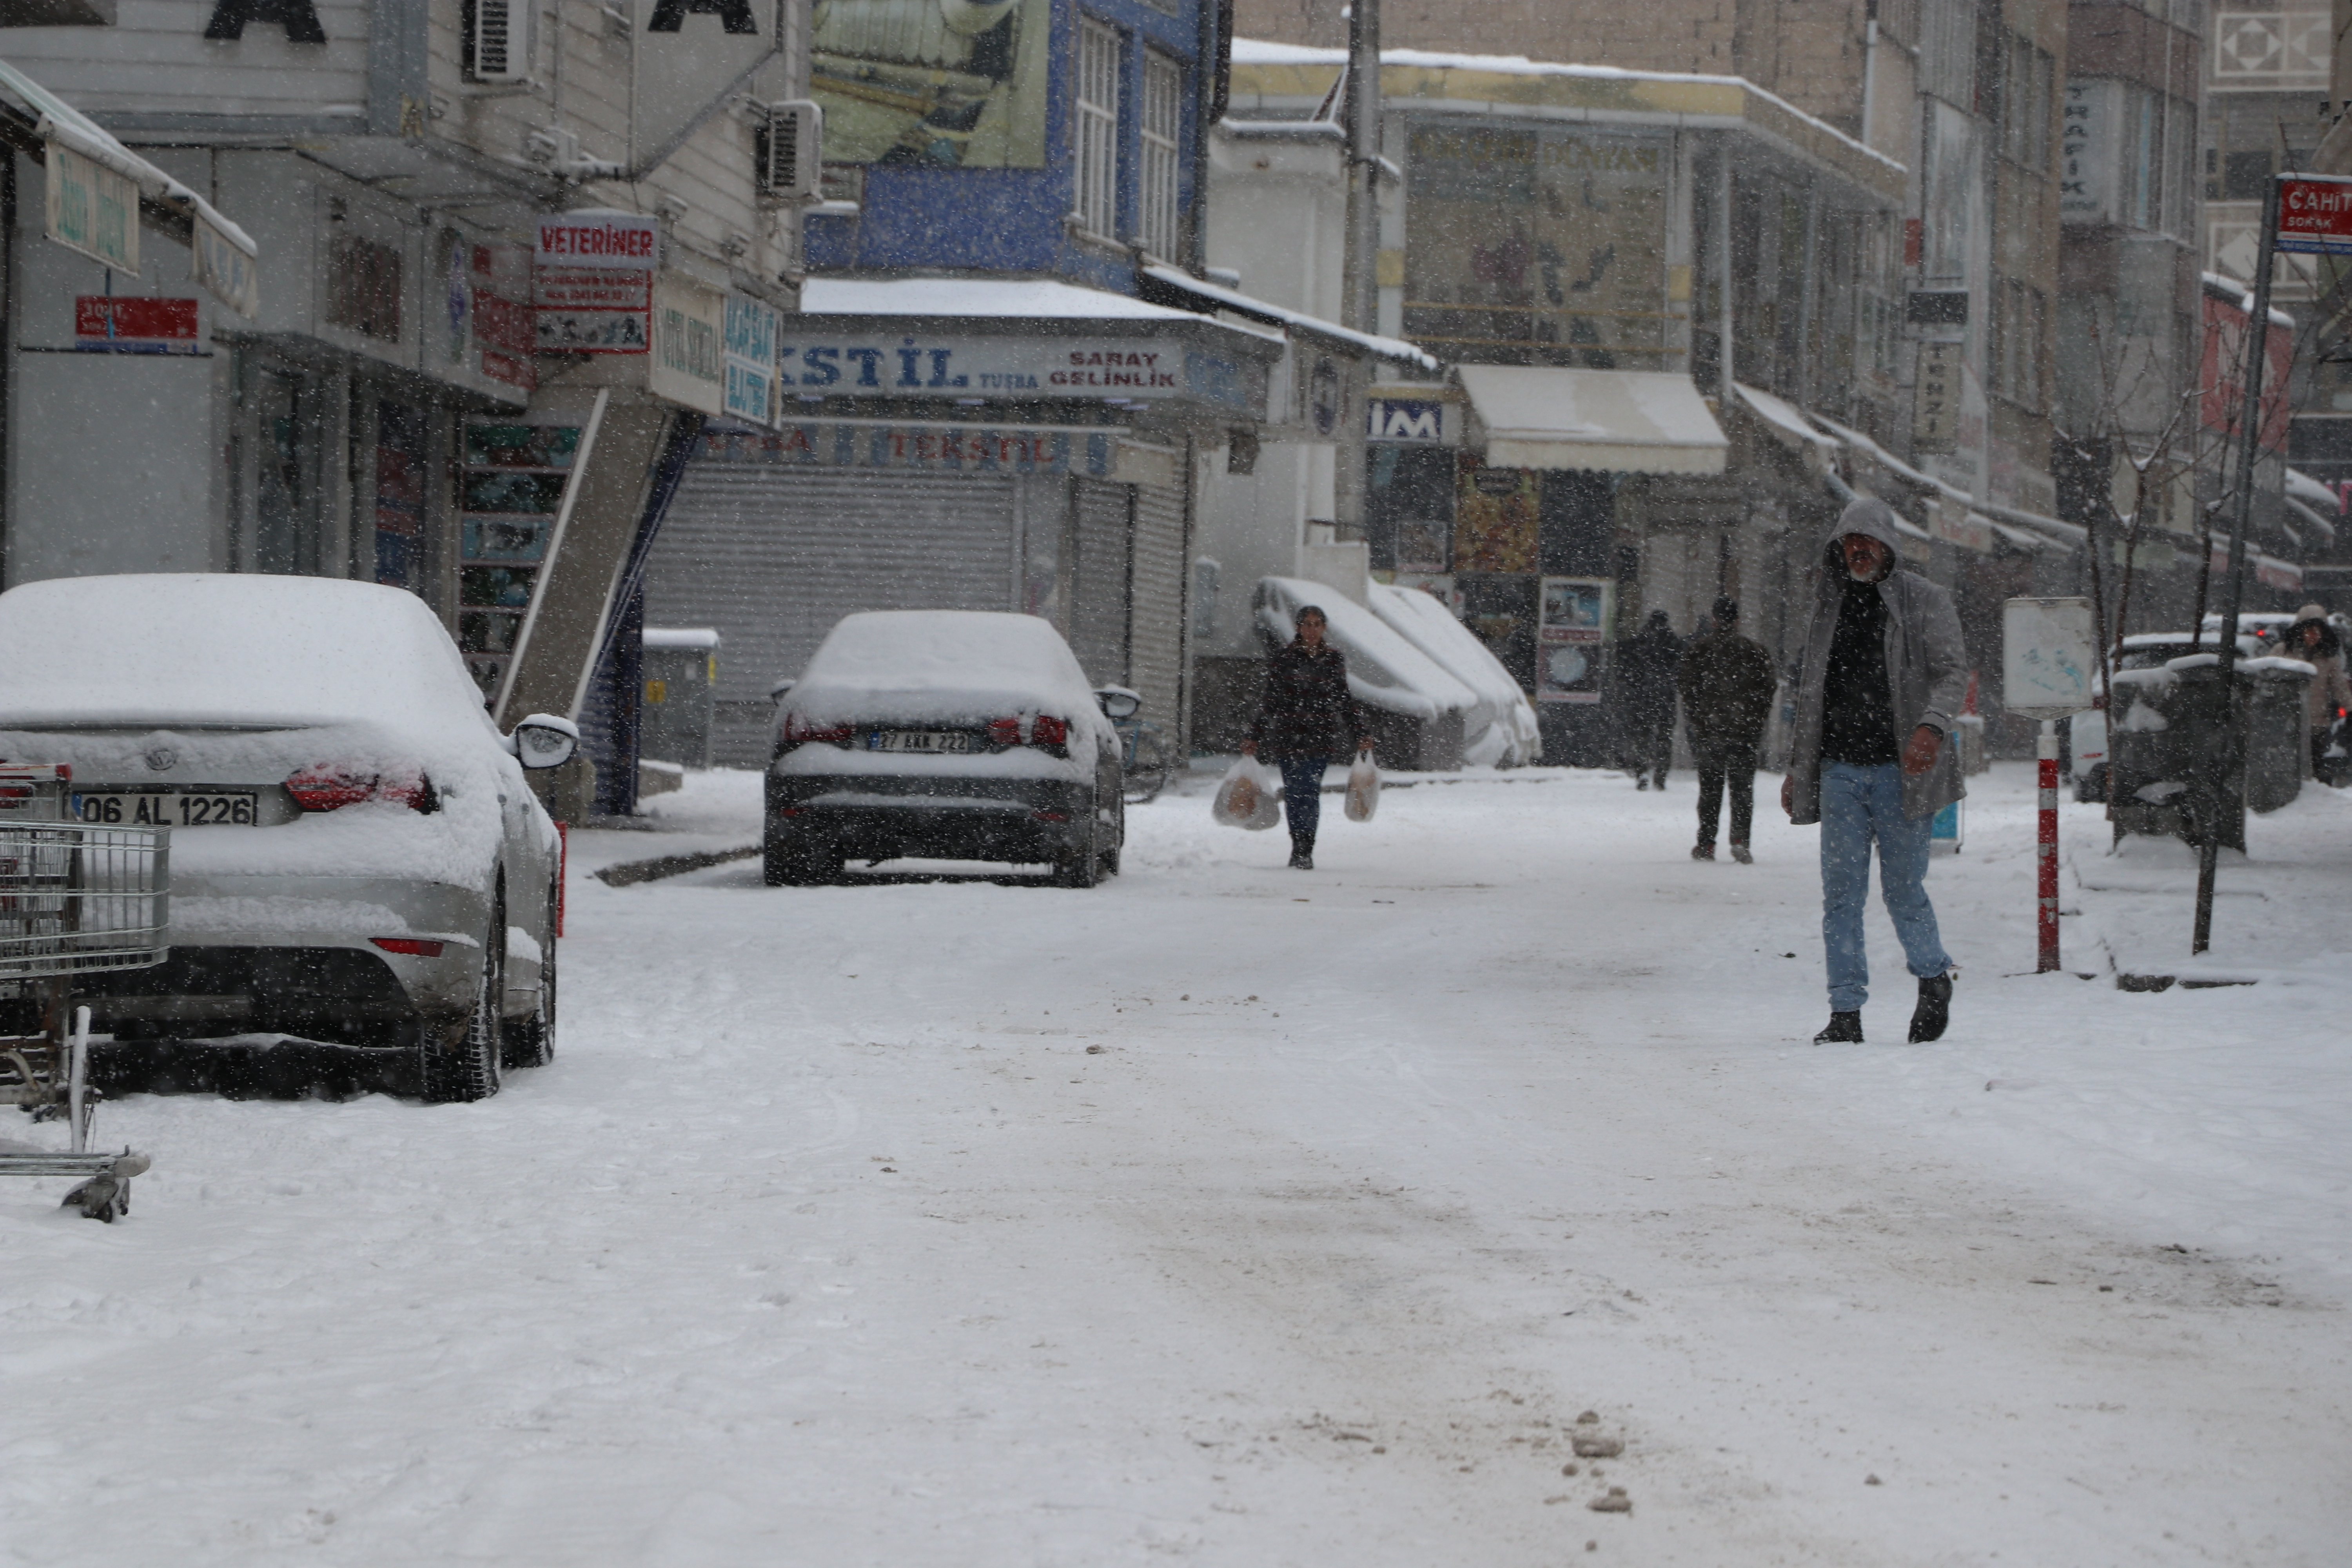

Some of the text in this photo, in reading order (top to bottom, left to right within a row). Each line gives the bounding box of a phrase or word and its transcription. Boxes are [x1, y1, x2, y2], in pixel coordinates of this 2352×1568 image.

[2287, 216, 2332, 230] SOKAK
[541, 222, 653, 257] VETERİNER
[1069, 351, 1158, 367] SARAY
[1049, 368, 1175, 387] GELİNLİK
[888, 432, 1055, 464] TEKSTİL
[880, 734, 898, 748] 27
[938, 735, 967, 750] 222
[83, 797, 252, 825] 06 AL 1226
